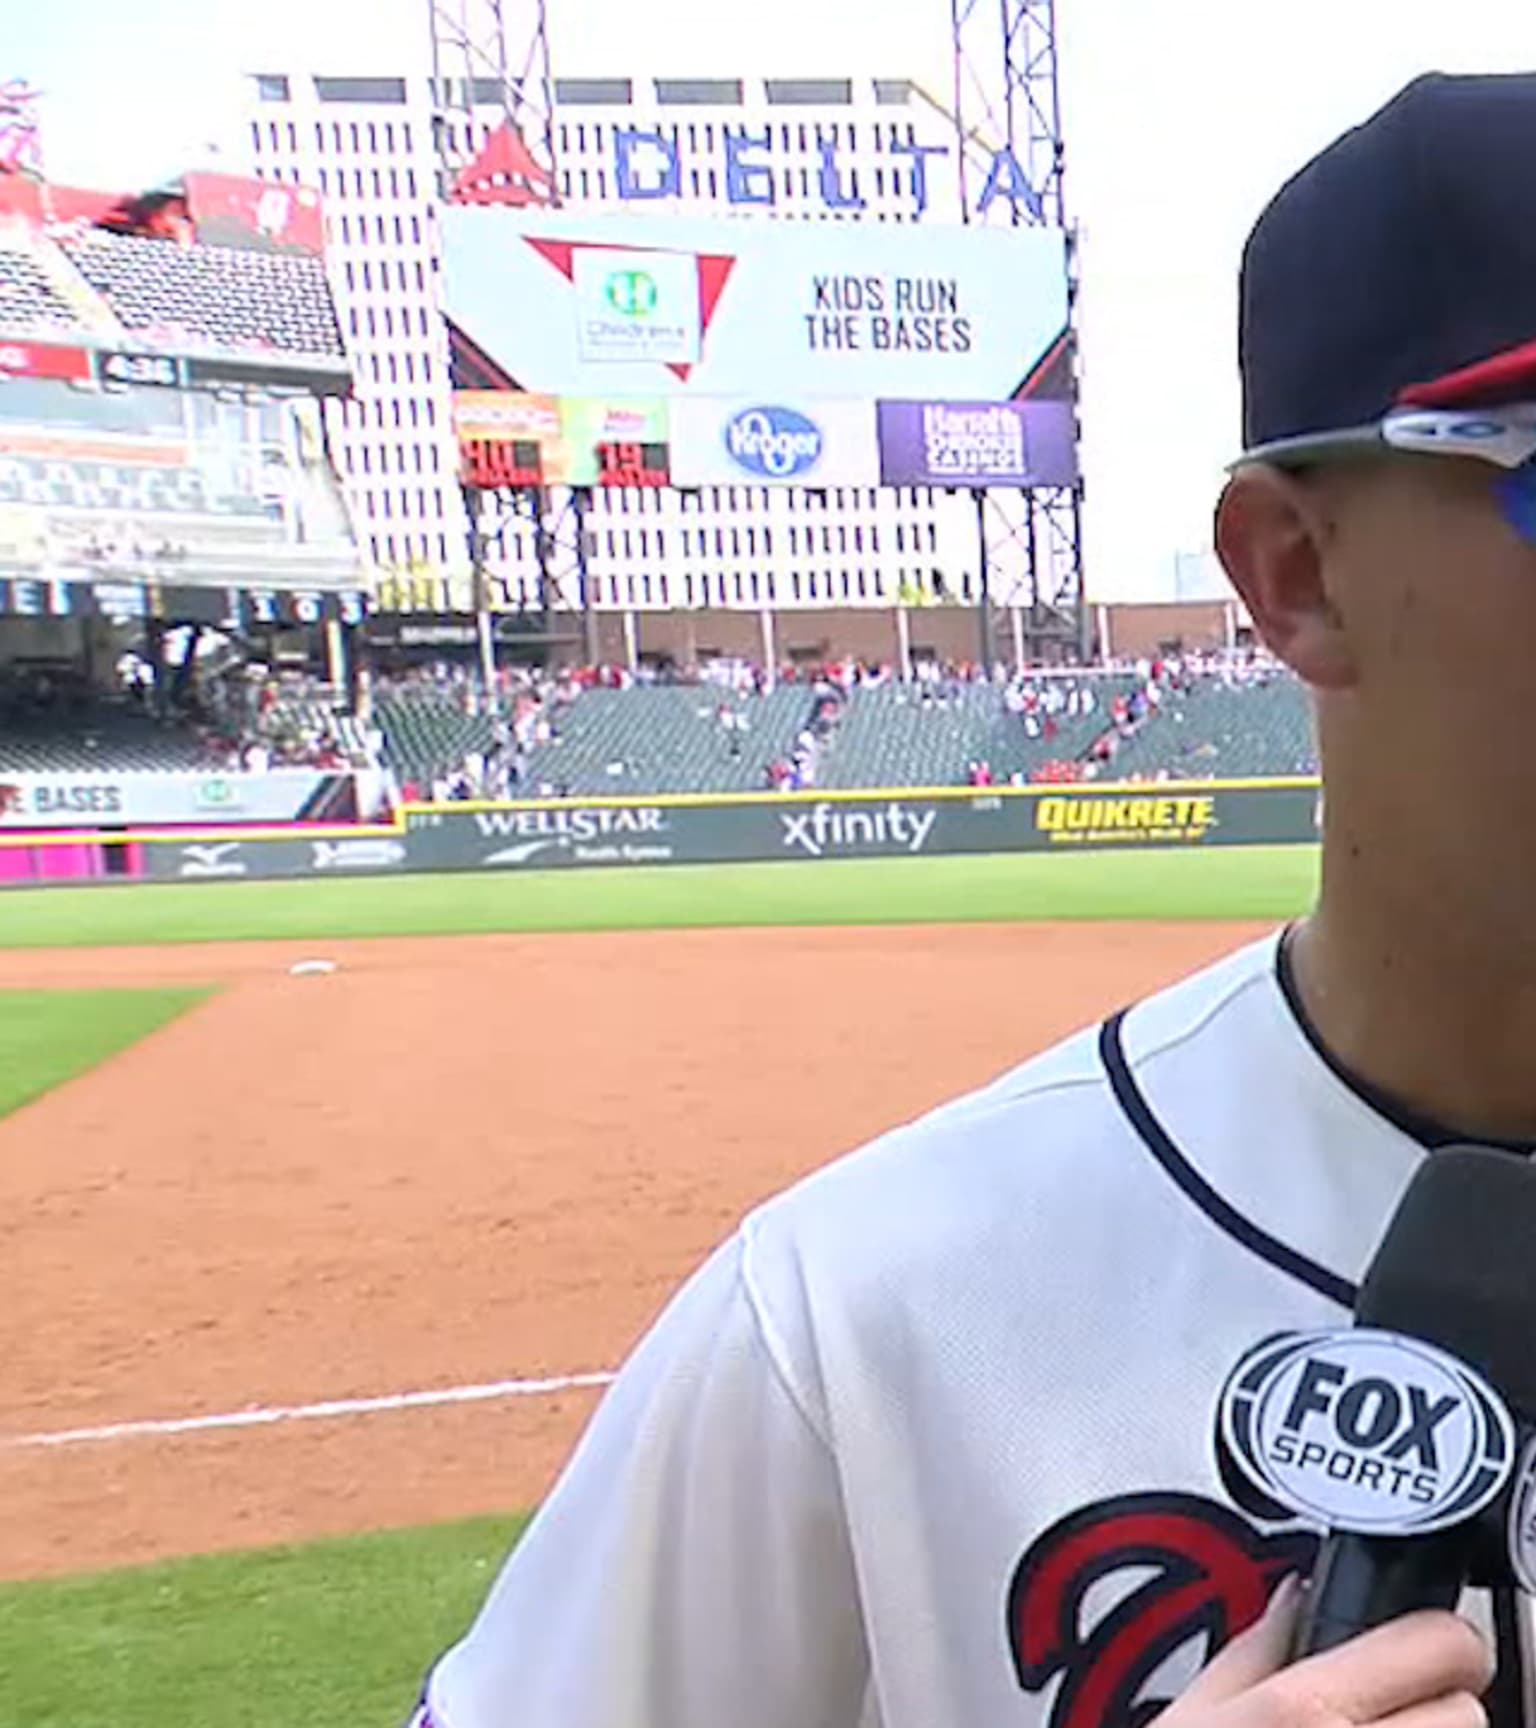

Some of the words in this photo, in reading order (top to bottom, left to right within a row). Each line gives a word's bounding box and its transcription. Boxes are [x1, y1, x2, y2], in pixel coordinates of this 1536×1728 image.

[613, 130, 1046, 221] DELTA
[812, 274, 885, 312] KIDS
[898, 277, 958, 314] RUN
[804, 314, 866, 351] THE
[872, 317, 973, 353] BASES
[731, 412, 820, 474] Kroger
[34, 786, 121, 813] BASES
[1036, 796, 1215, 831] QUIKRETE
[475, 807, 666, 840] WELLSTAR
[781, 803, 937, 855] xfinity
[1282, 1357, 1461, 1473] FOX
[1269, 1433, 1440, 1502] SPORTS
